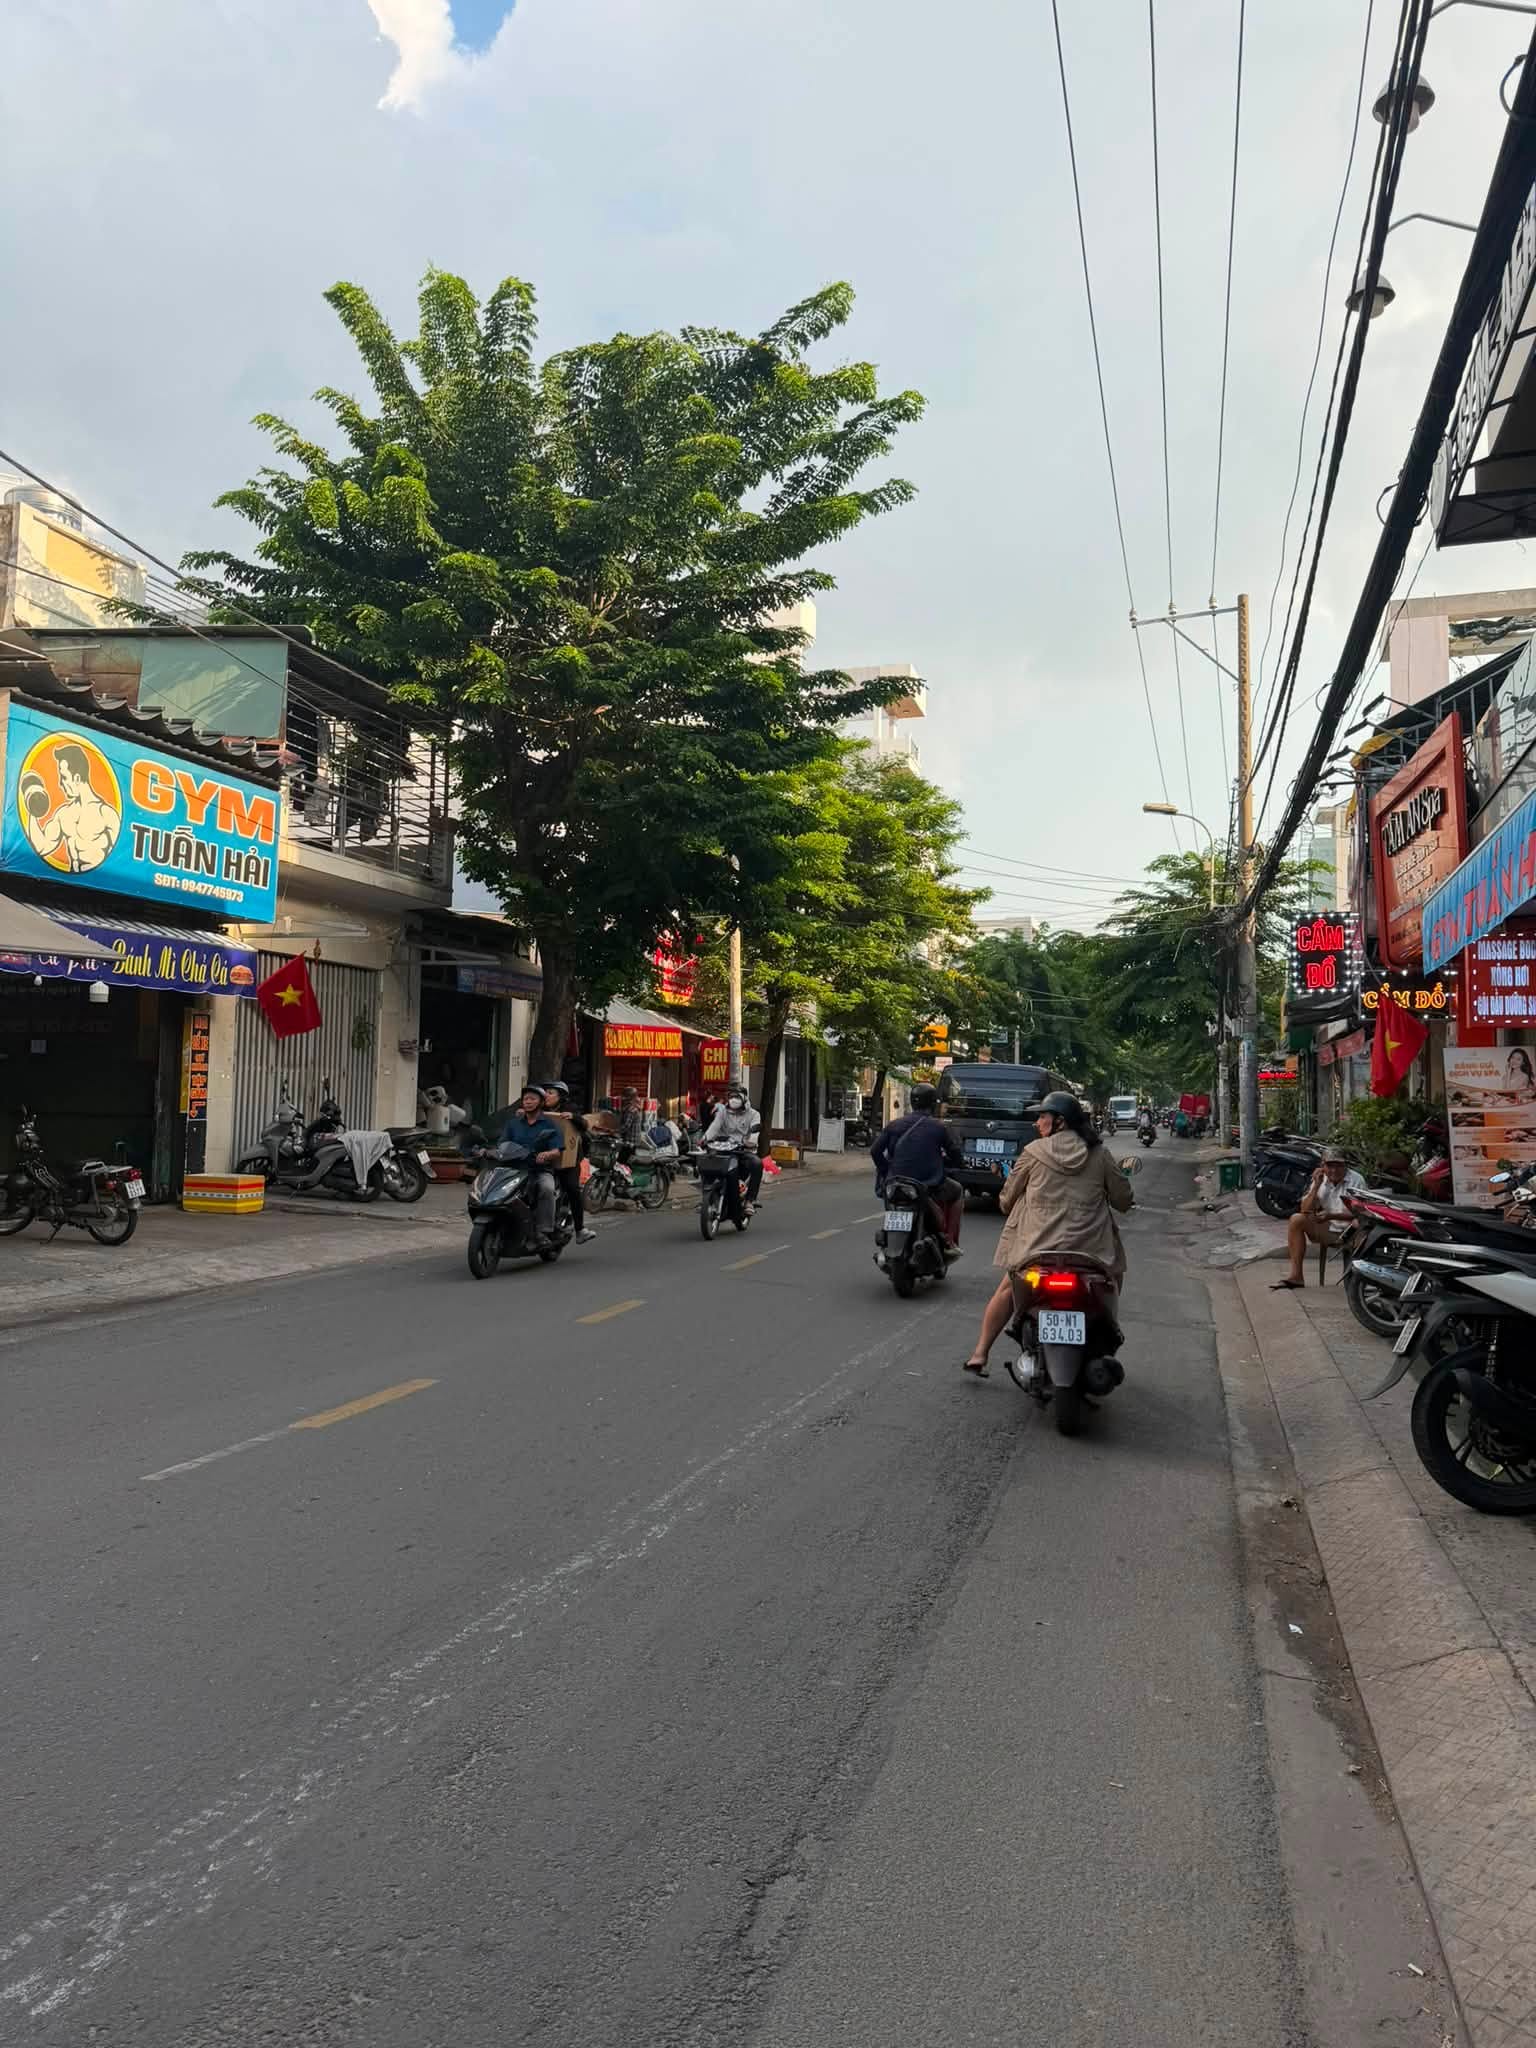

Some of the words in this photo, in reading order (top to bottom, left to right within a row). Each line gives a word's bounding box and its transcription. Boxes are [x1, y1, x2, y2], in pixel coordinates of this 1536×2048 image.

[131, 759, 276, 845] GYM
[1421, 787, 1441, 831] Spa
[131, 823, 218, 877] TUẤN
[222, 845, 271, 890] HẢI
[1478, 940, 1518, 960] MASSAGE
[181, 949, 207, 983] Chả
[210, 952, 228, 986] Cá
[1490, 962, 1513, 986] XÔNG
[703, 1065, 728, 1081] MAY
[1046, 1314, 1076, 1328] 50-N1
[1042, 1328, 1082, 1343] 634.03
